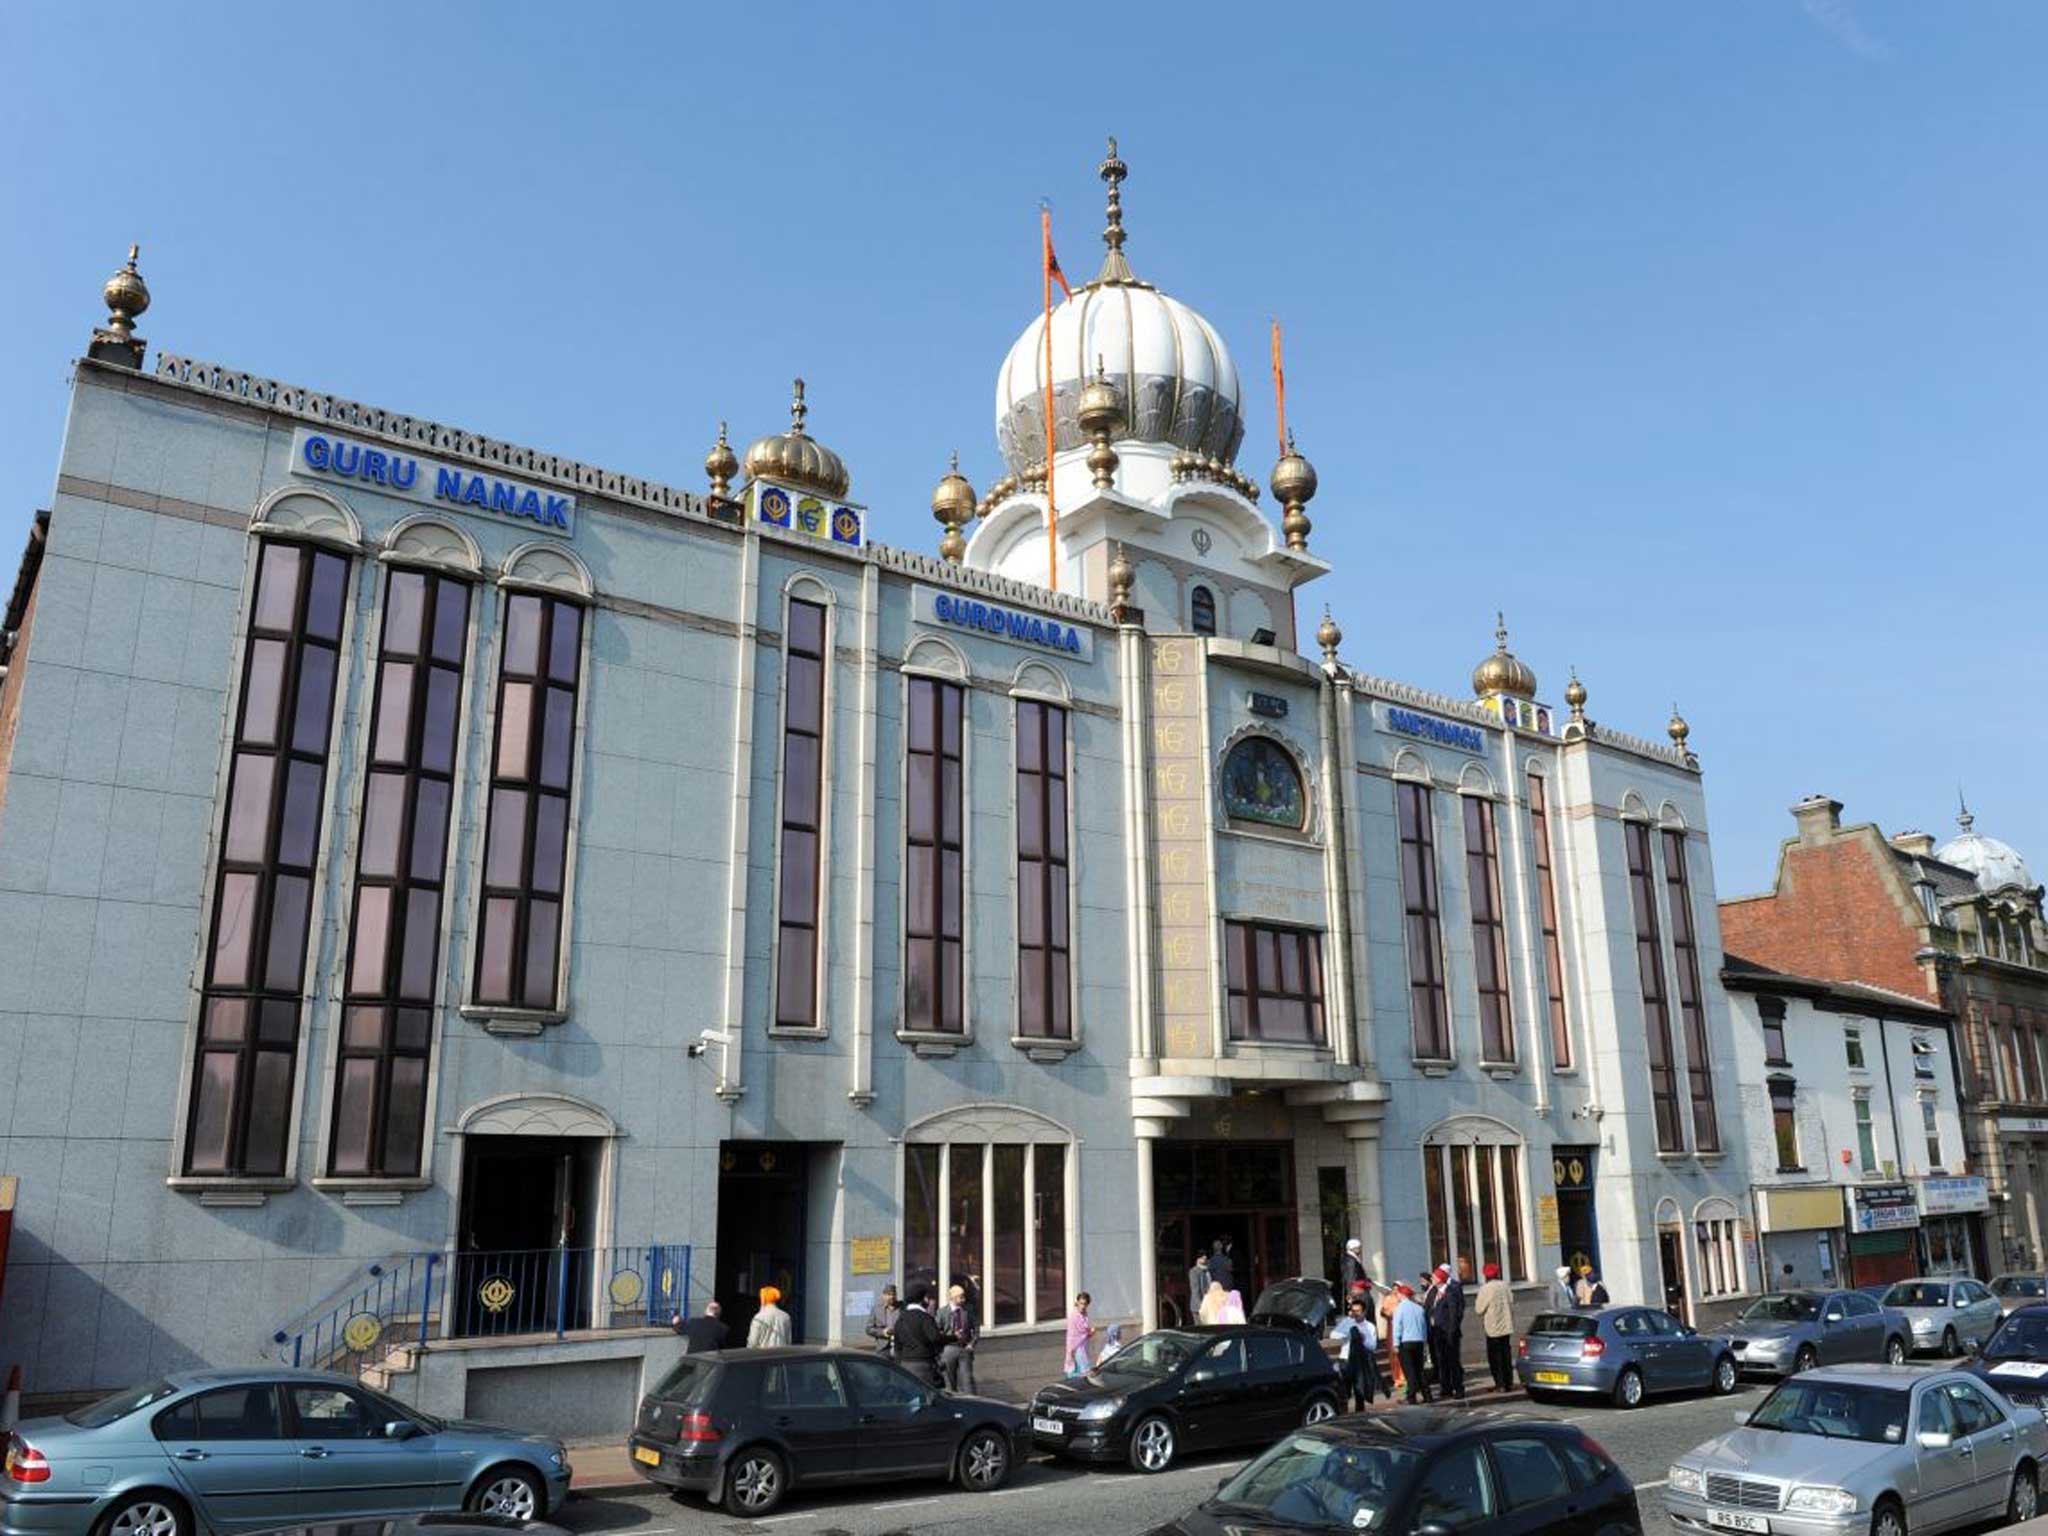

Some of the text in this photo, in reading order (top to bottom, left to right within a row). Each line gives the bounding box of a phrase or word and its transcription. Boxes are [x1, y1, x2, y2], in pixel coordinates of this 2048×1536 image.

[303, 436, 568, 529] GURU NANAK
[936, 595, 1081, 653] GURDWARA
